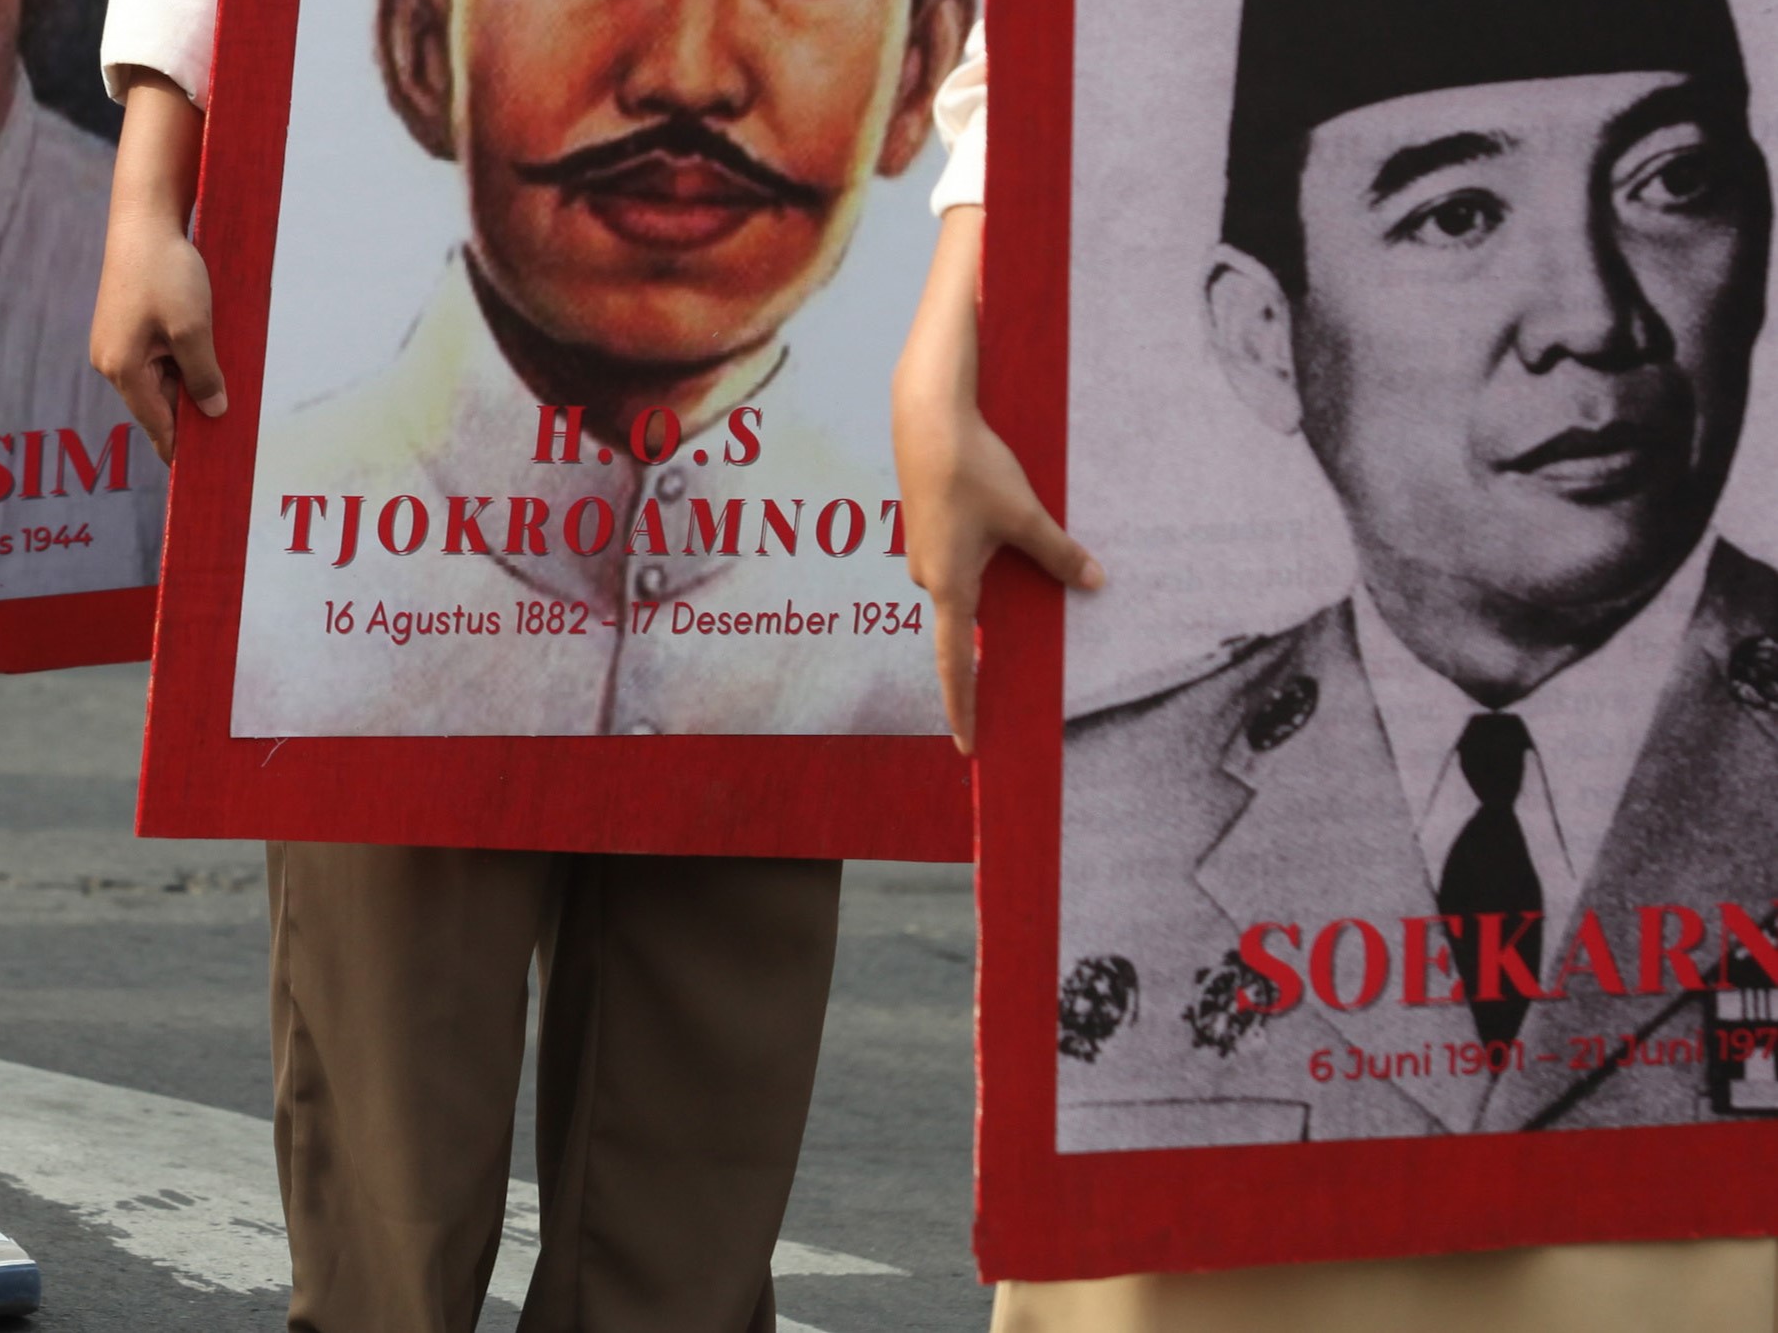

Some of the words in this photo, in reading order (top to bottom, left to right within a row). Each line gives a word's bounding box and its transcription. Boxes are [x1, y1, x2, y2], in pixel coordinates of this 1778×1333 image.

[531, 405, 764, 466] H.O.S
[22, 522, 93, 554] 1944
[280, 494, 908, 569] TJOKROAMNOT
[324, 600, 355, 635] 16
[366, 601, 502, 645] Agustus
[514, 600, 590, 635] 1882
[630, 600, 658, 634] 17
[671, 599, 839, 635] Desember
[852, 600, 923, 635] 1934
[1236, 901, 1778, 1015] SOEKARN
[1308, 1049, 1332, 1083] 6
[1341, 1043, 1431, 1079] Juni
[1444, 1040, 1524, 1074] 1901
[1568, 1036, 1606, 1070] 21
[1613, 1027, 1704, 1068] Juni
